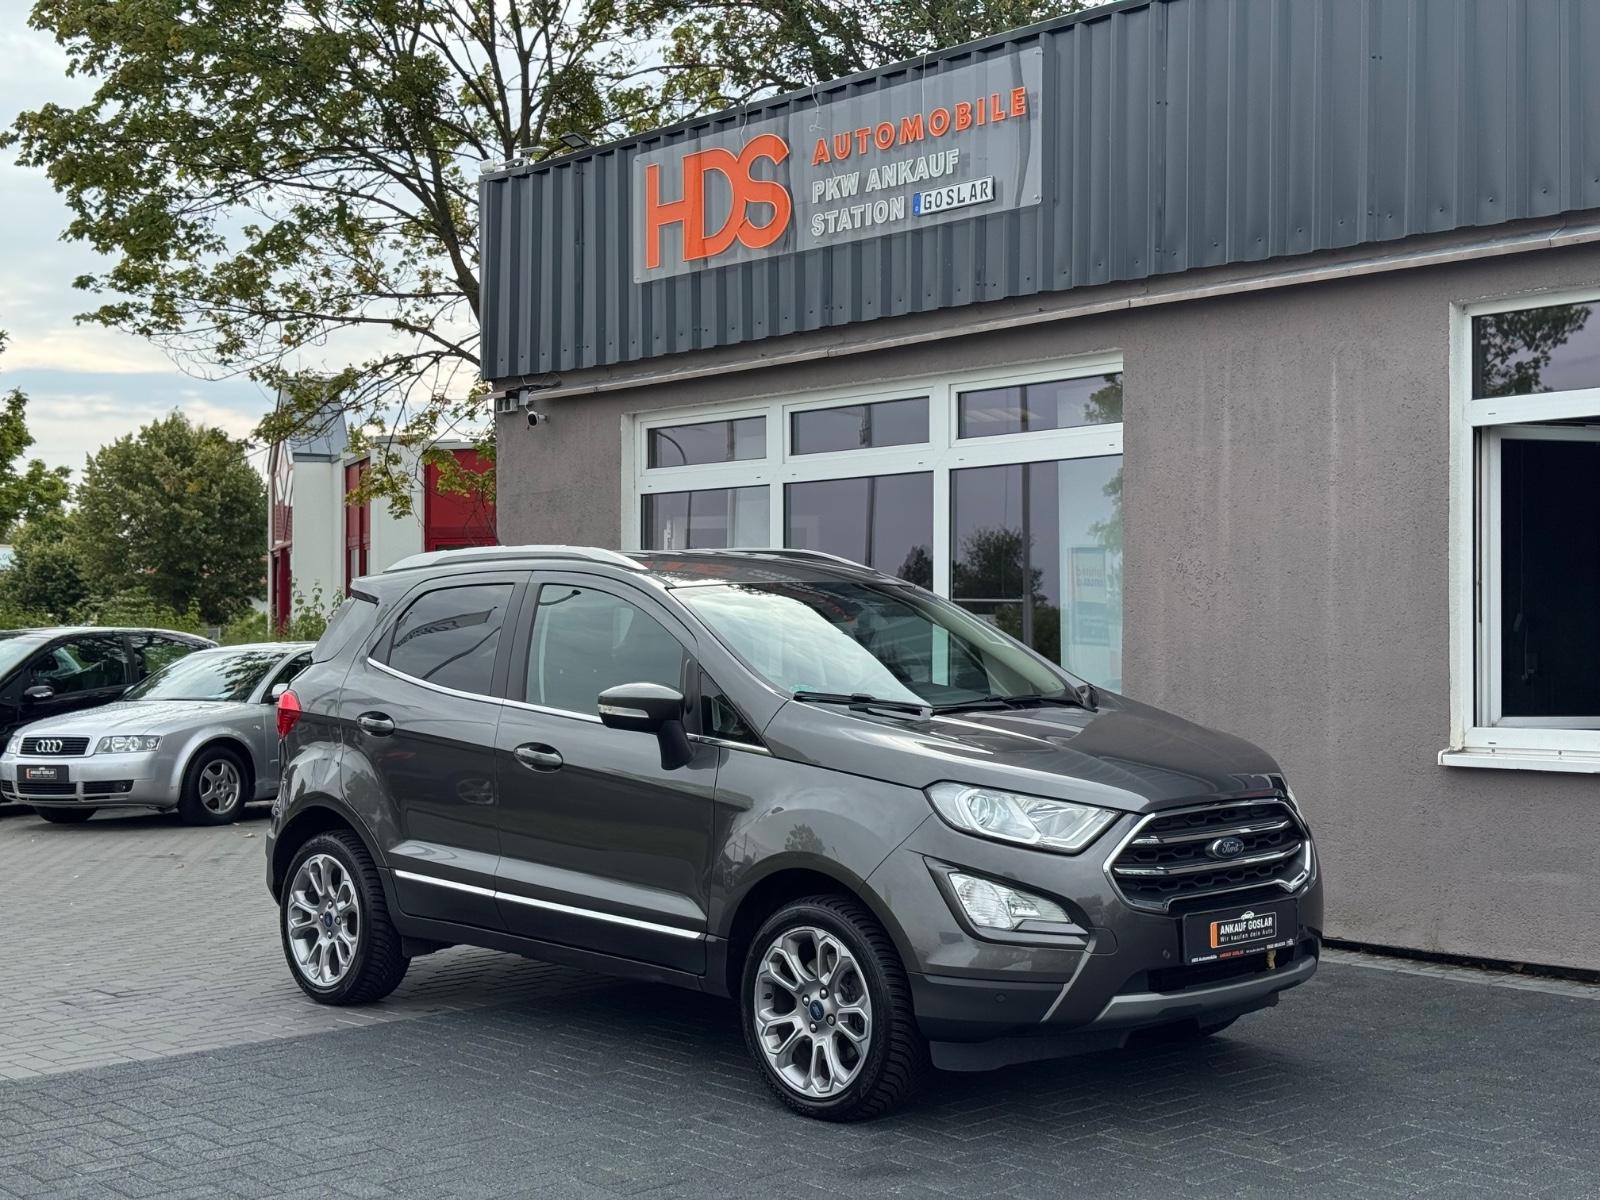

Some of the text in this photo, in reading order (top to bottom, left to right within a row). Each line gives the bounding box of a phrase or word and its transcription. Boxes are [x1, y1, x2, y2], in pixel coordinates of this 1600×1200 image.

[811, 87, 1026, 166] AUTOMOBILE
[645, 133, 792, 269] HDS
[812, 148, 960, 204] PKW ANKAUF
[811, 180, 989, 237] STATION GOSLAR
[1220, 917, 1273, 935] ANKAUF GOSLAR
